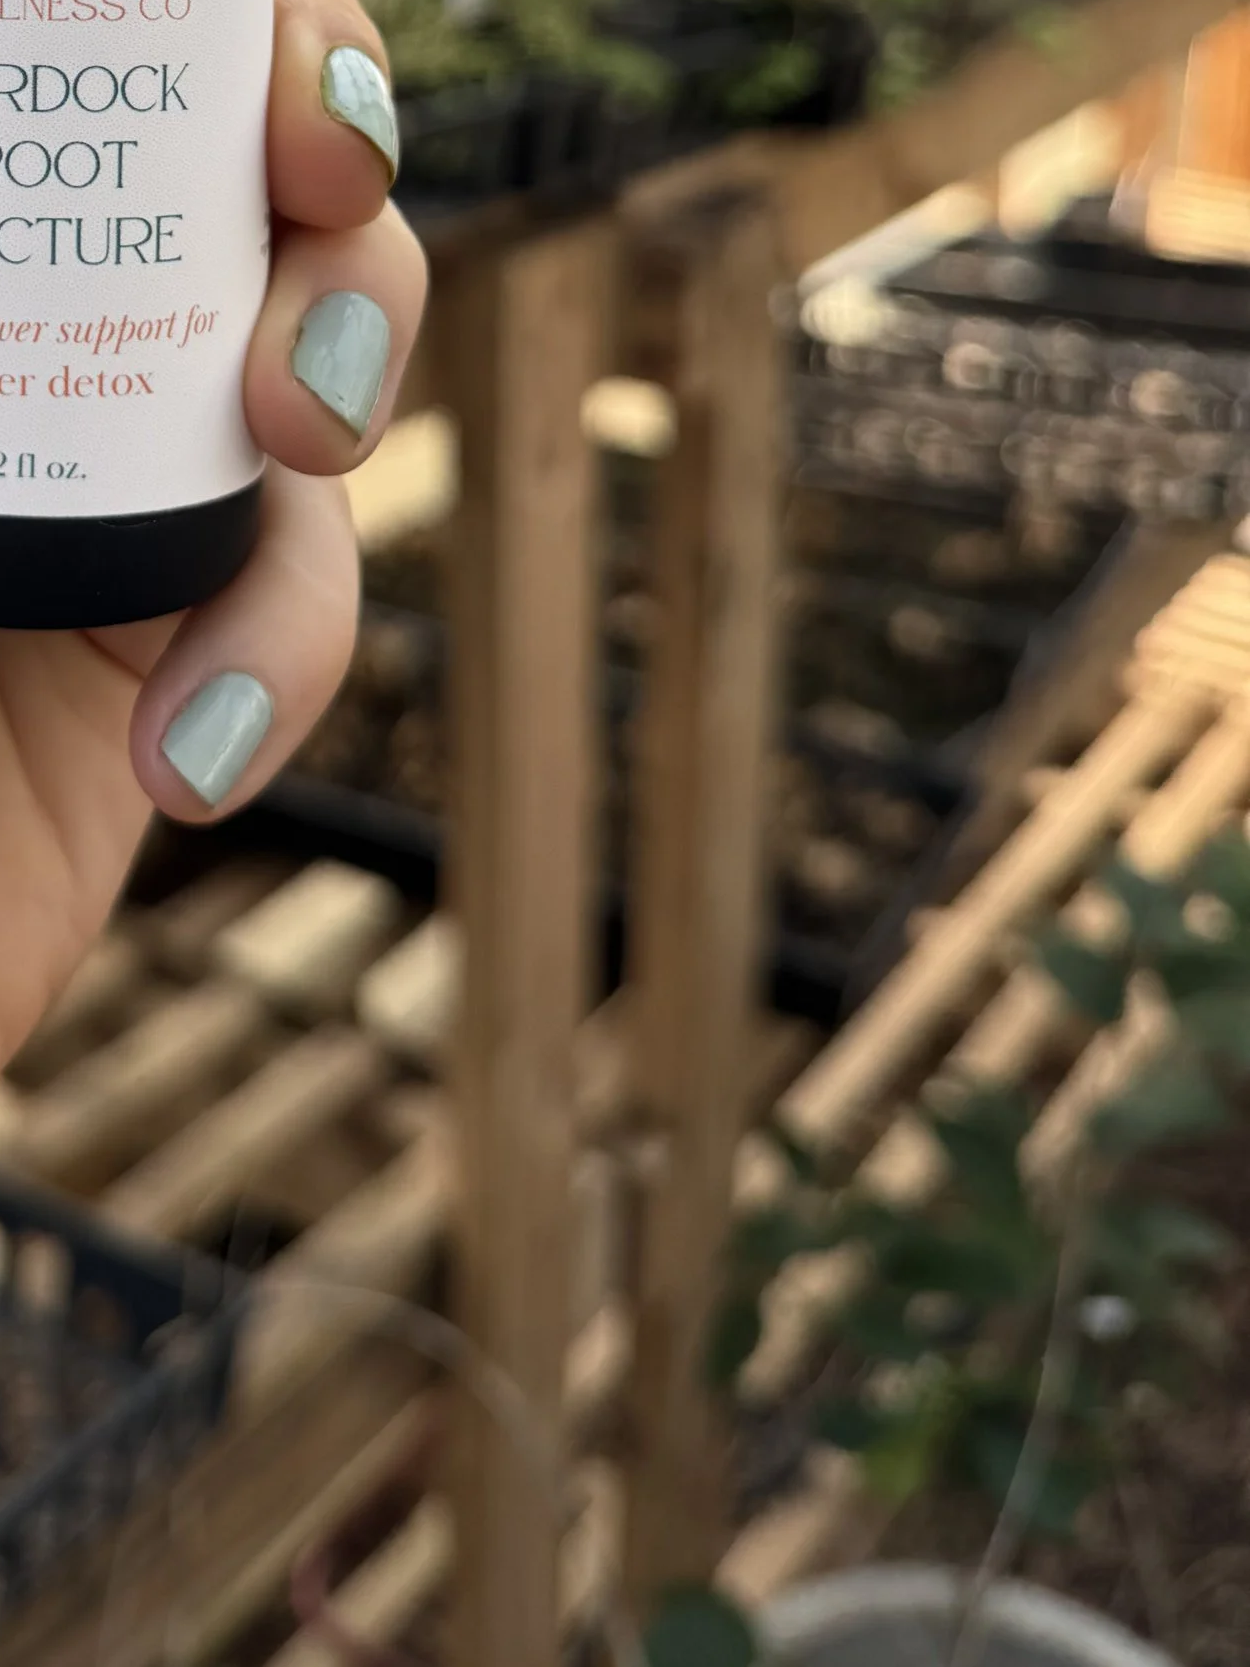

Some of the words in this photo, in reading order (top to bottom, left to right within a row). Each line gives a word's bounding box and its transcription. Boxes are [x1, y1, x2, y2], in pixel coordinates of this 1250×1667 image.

[54, 312, 177, 356] support
[177, 304, 220, 348] for
[47, 364, 156, 399] detox
[16, 452, 38, 480] fl
[46, 461, 87, 480] oz.
